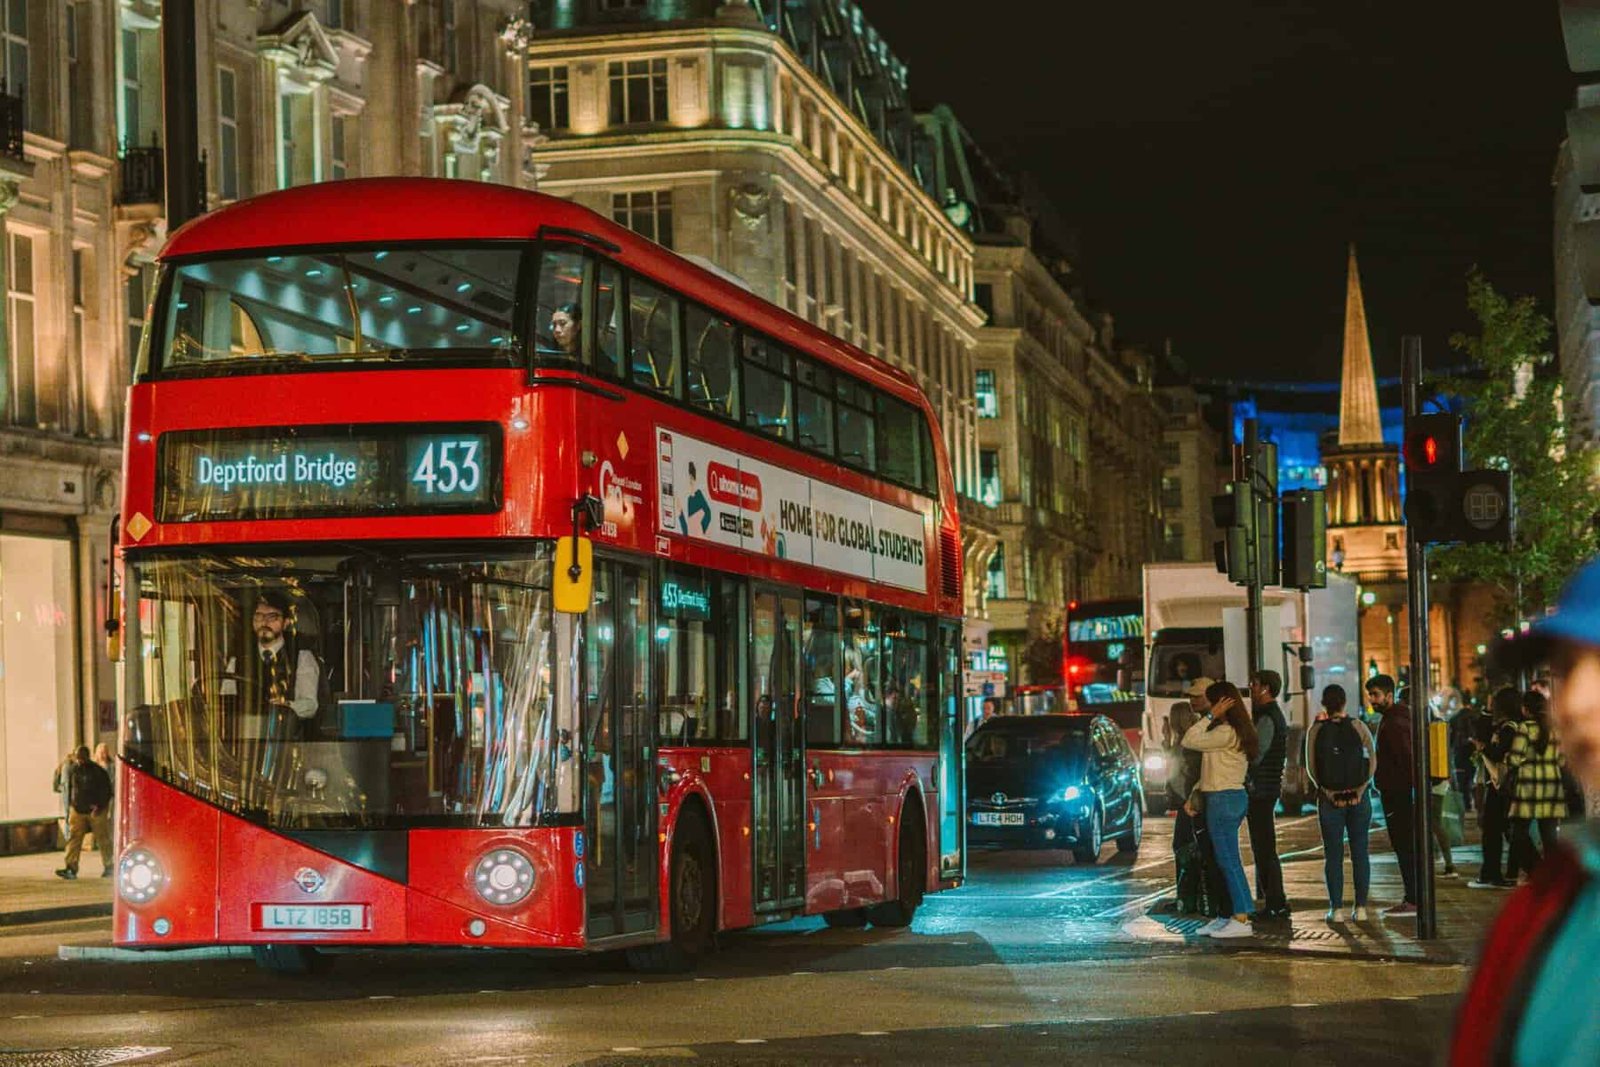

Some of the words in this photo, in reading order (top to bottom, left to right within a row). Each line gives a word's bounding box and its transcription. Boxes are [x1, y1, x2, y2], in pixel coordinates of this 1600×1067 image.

[200, 454, 286, 491] Deptford
[294, 453, 356, 487] Bridge
[412, 441, 480, 493] 453
[779, 499, 813, 537] HOME
[815, 510, 836, 543] FOR
[838, 517, 877, 554] GLOBAL
[879, 528, 923, 566] STUDENTS
[662, 582, 678, 608] 453
[273, 908, 306, 926] LTZ
[312, 908, 352, 926] 1858
